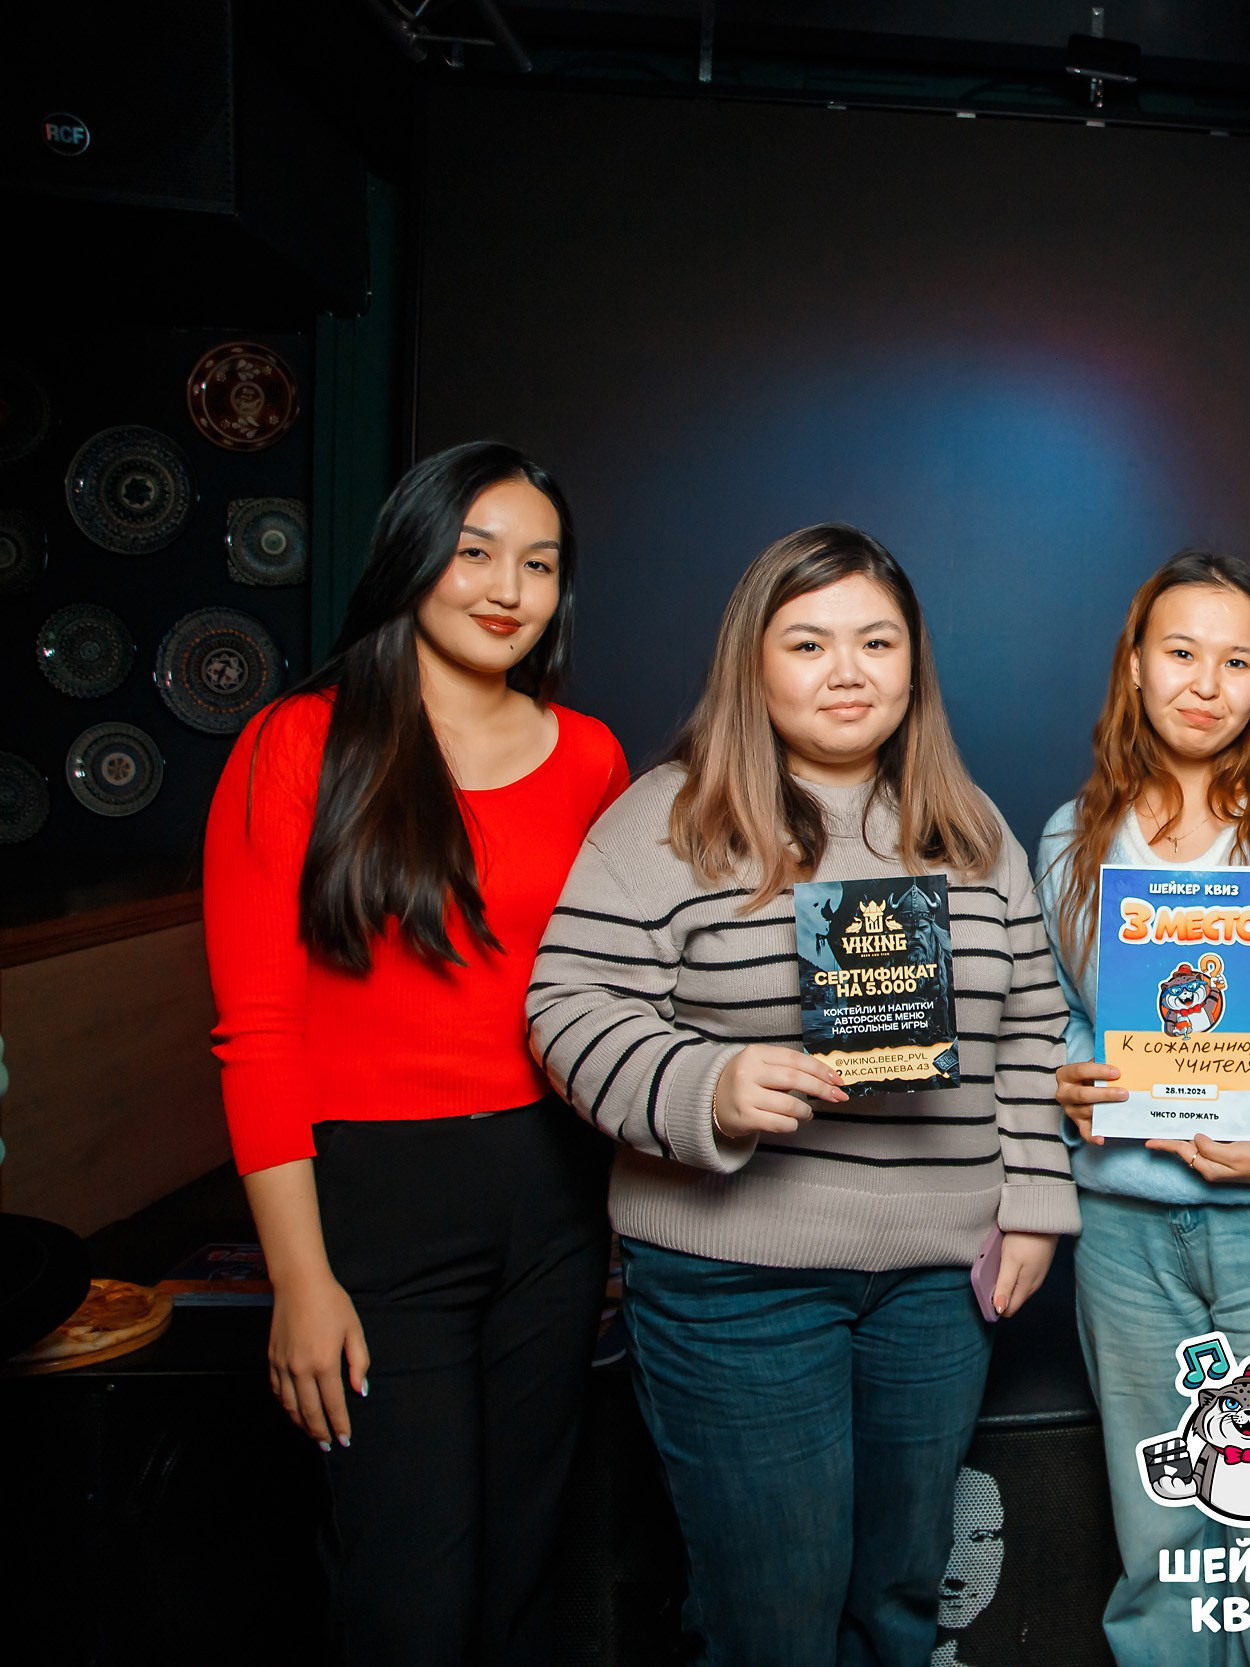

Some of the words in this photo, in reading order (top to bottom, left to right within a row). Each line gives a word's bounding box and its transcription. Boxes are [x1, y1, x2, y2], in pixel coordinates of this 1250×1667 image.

[45, 123, 84, 144] RCF
[1149, 881, 1200, 895] ШЕЙКЕР
[1204, 884, 1239, 896] КВИЗ
[1121, 900, 1152, 942] 3
[841, 934, 907, 954] VIKING
[814, 963, 937, 986] СЕРТИФИКАТ
[836, 983, 863, 998] НА
[865, 979, 917, 996] 5.000
[823, 1005, 876, 1017] КОКТЕЙЛИ
[878, 1005, 886, 1013] И
[888, 1001, 934, 1012] НАПИТКИ
[834, 1014, 892, 1026] АВТОРСКОЕ
[895, 1011, 925, 1021] МЕНЮ
[832, 1022, 899, 1035] НАСТОЛЬНЫЕ
[901, 1020, 929, 1030] ИГРЫ
[1122, 1034, 1134, 1052] К
[835, 1052, 928, 1067] @VIKING.BEER_PVL
[844, 1064, 914, 1077] АК.САТПАЕВА
[916, 1063, 930, 1071] 43
[1165, 1086, 1207, 1096] 28.11.2024
[1150, 1111, 1176, 1119] ЧИСТО
[1179, 1112, 1219, 1120] ПОРЖАТЬ
